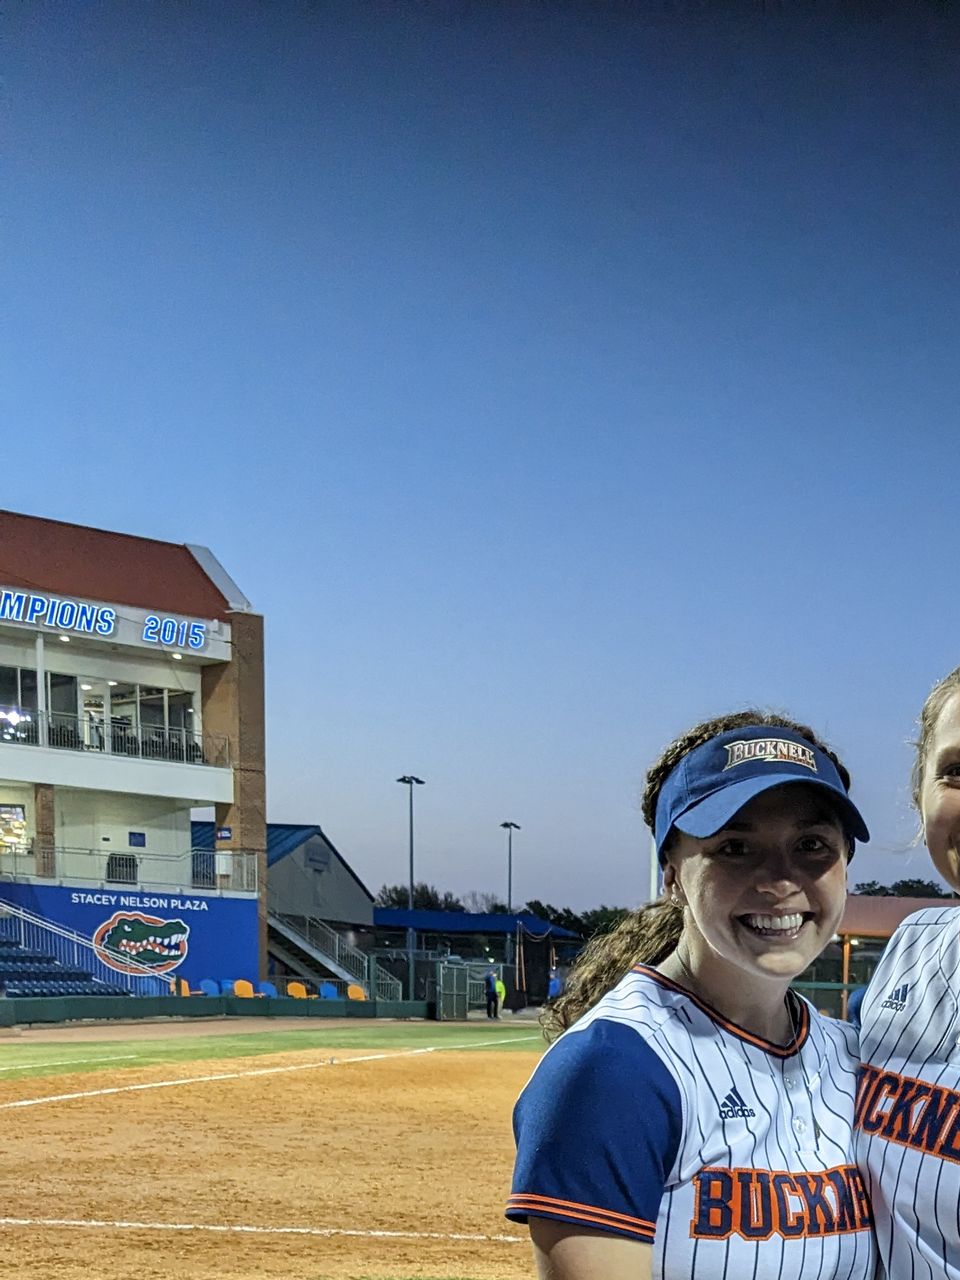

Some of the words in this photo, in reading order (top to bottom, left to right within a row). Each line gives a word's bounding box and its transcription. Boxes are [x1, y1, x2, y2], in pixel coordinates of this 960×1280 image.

[142, 615, 207, 648] 2015
[731, 740, 813, 764] BUCKNELL
[71, 893, 117, 906] STACEY
[120, 896, 168, 909] NELSON
[171, 900, 208, 911] PLAZA
[719, 1107, 756, 1120] adidas
